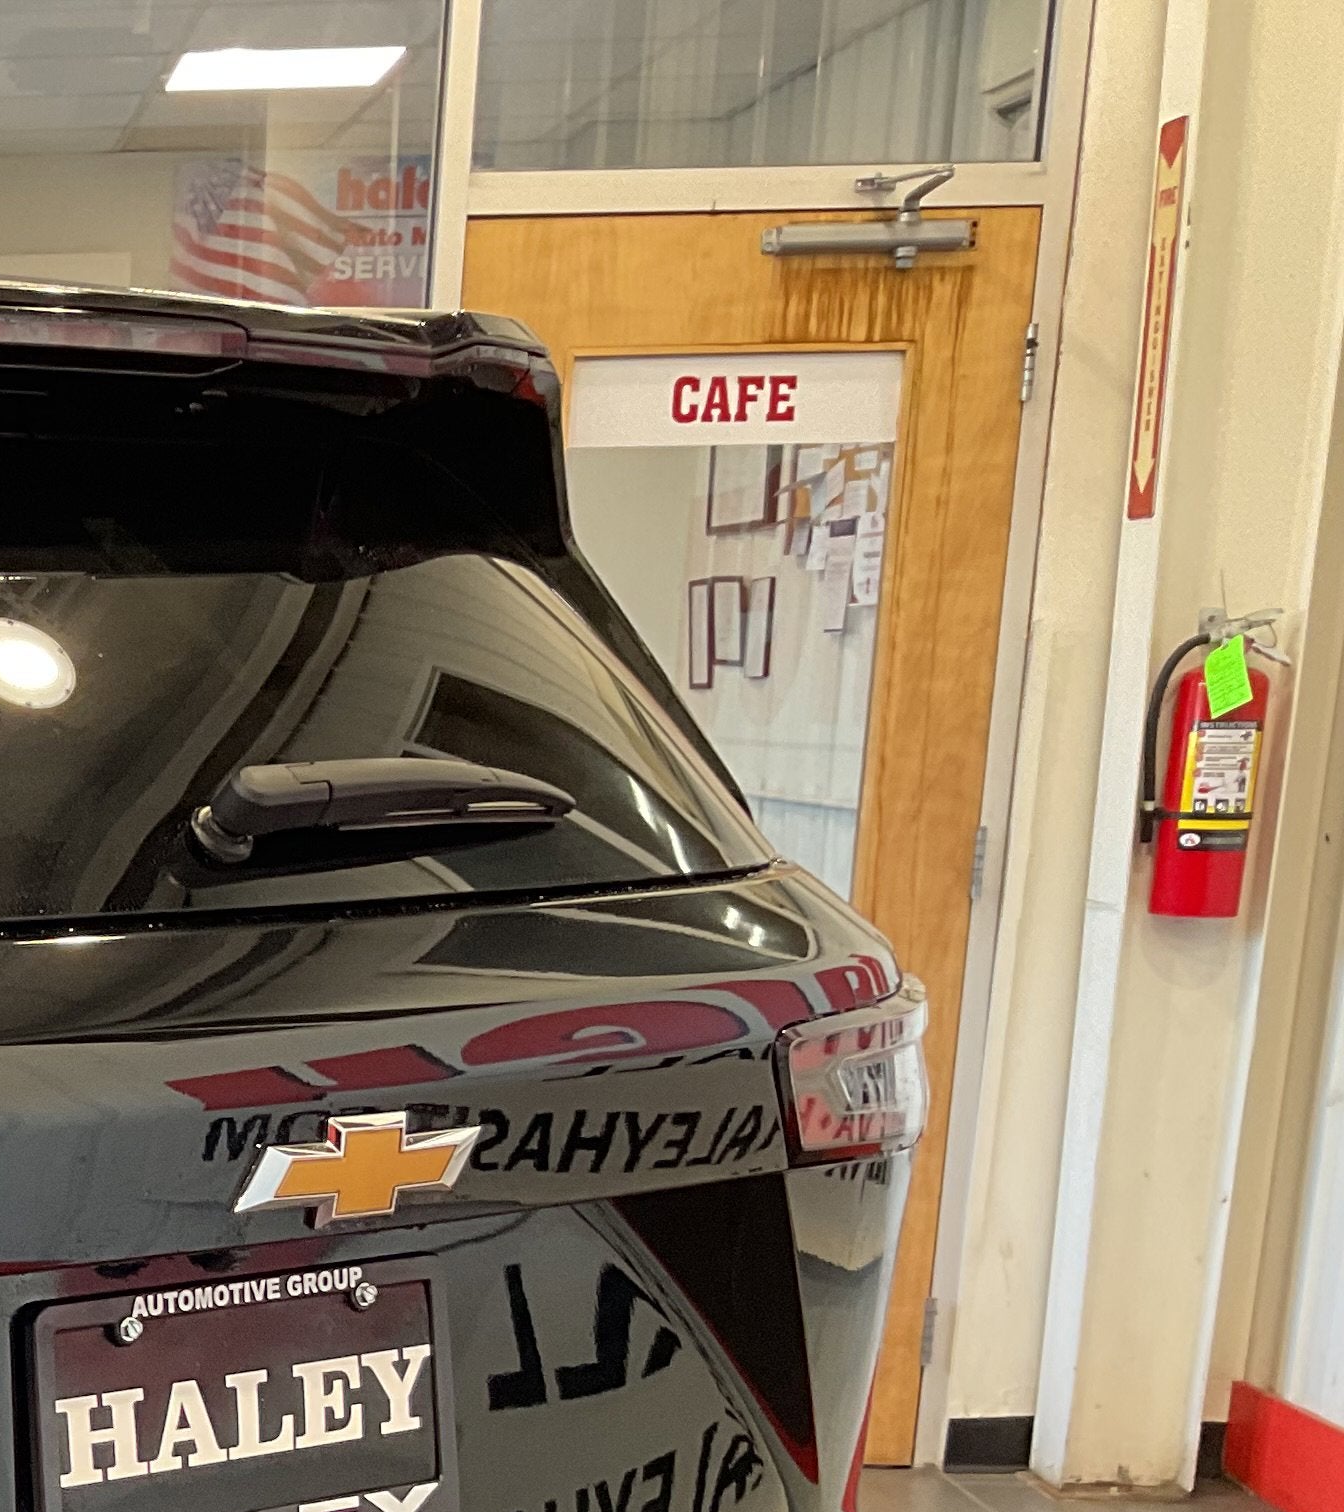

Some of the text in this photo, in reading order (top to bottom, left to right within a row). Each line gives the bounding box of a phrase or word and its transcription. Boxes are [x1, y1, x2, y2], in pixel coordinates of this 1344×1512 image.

[671, 375, 798, 424] CAFE
[130, 1267, 363, 1319] AUTOMOTIVE GROUP
[55, 1344, 431, 1489] HALEY
